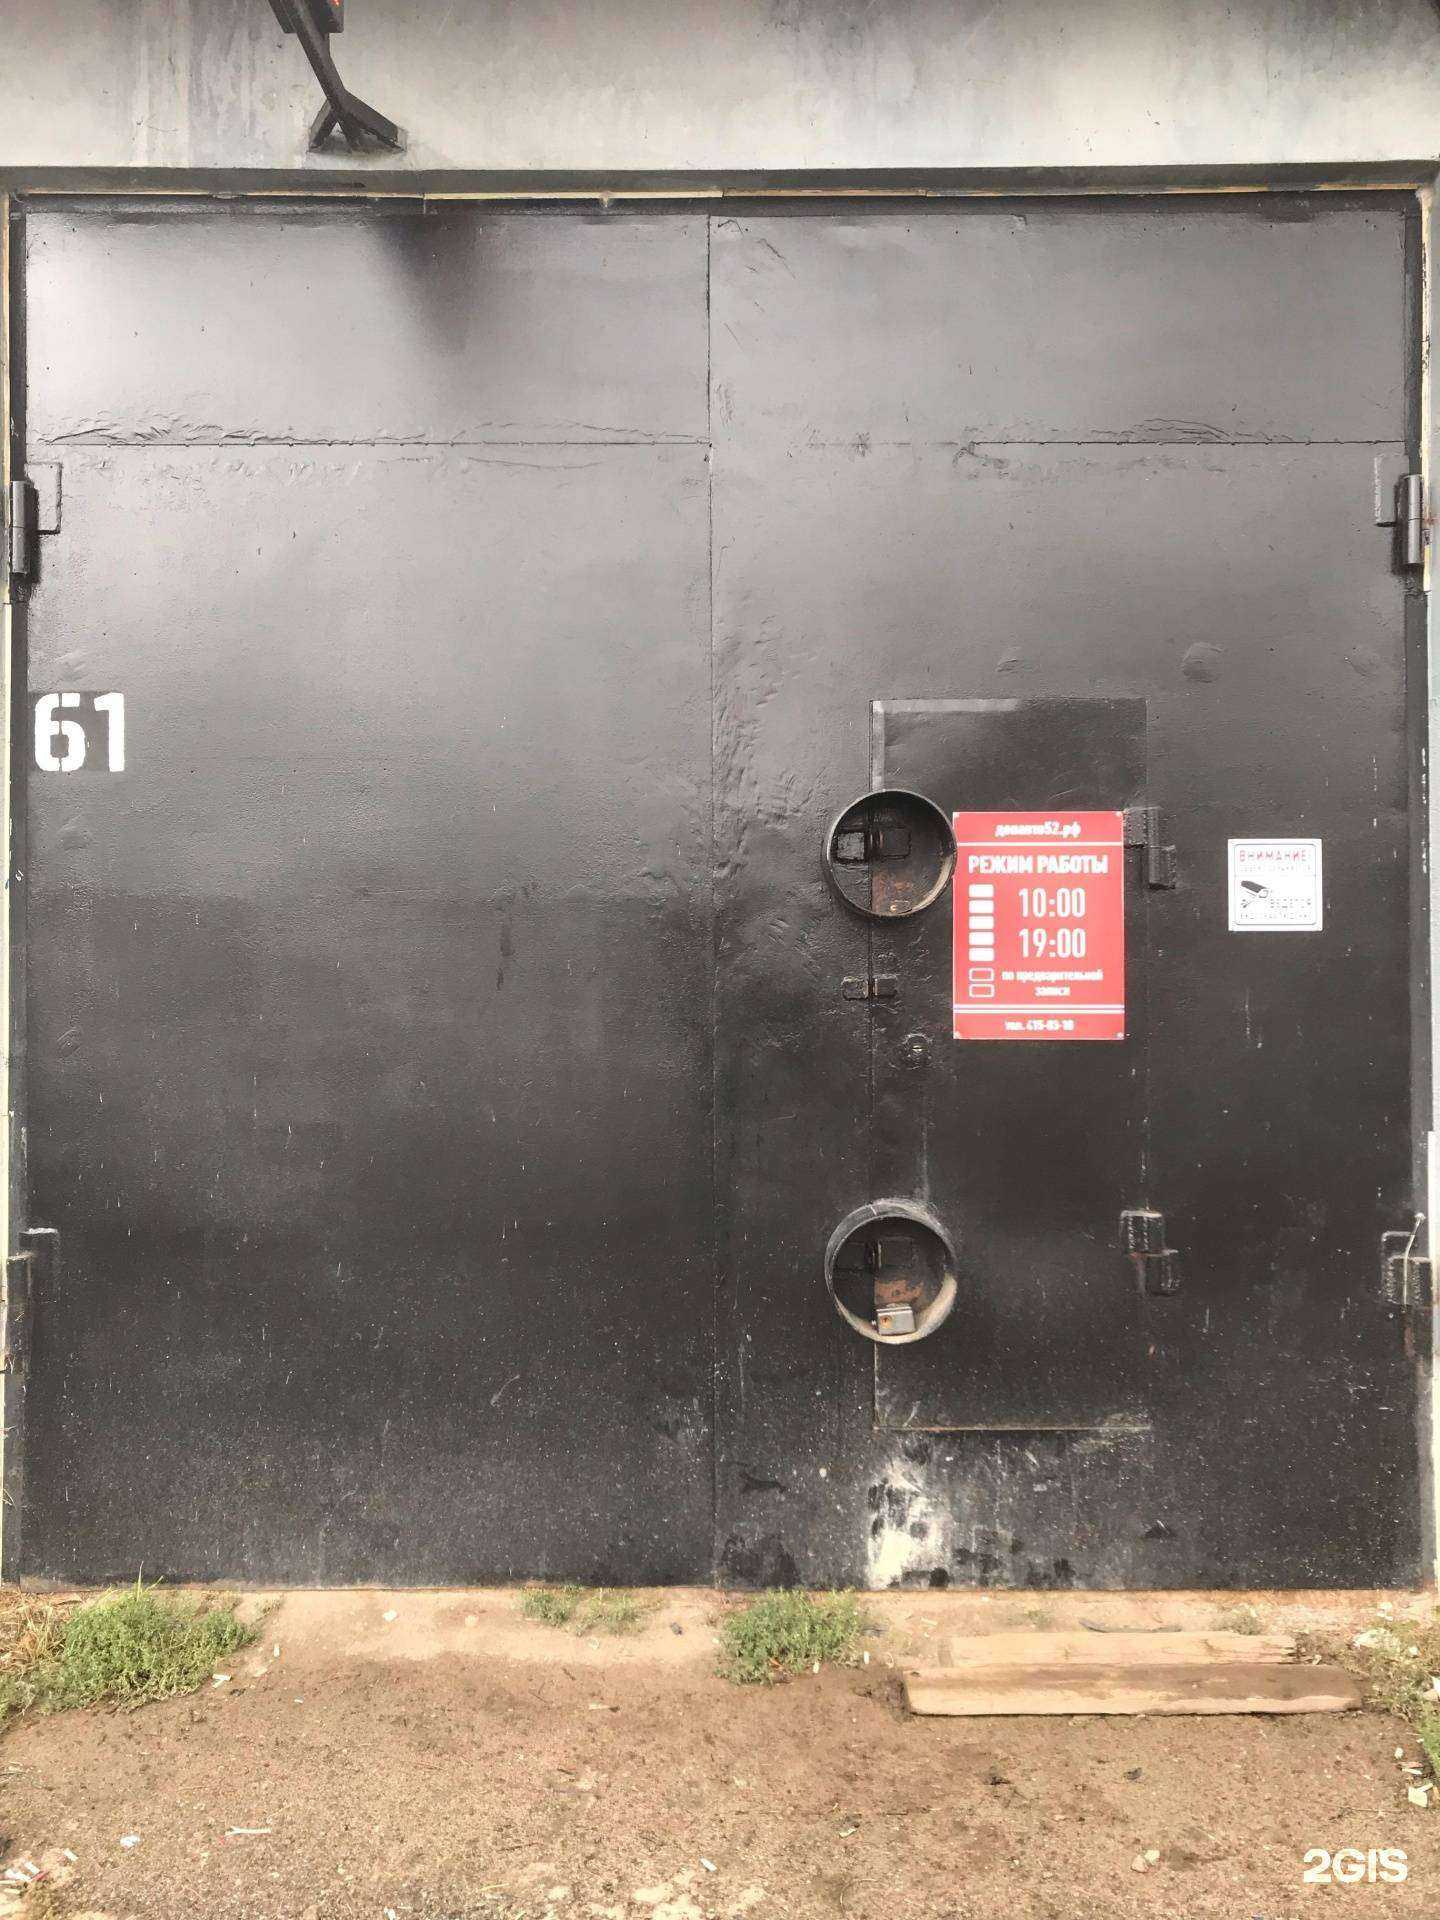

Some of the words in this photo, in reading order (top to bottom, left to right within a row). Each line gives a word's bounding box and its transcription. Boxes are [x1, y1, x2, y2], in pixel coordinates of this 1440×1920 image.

[35, 692, 125, 772] 61
[968, 854, 1034, 874] РЕЖИМ
[1036, 854, 1109, 874] РАБОТЫ
[1018, 887, 1086, 918] 10:00
[1018, 928, 1087, 959] 19:00
[1001, 970, 1014, 981] по
